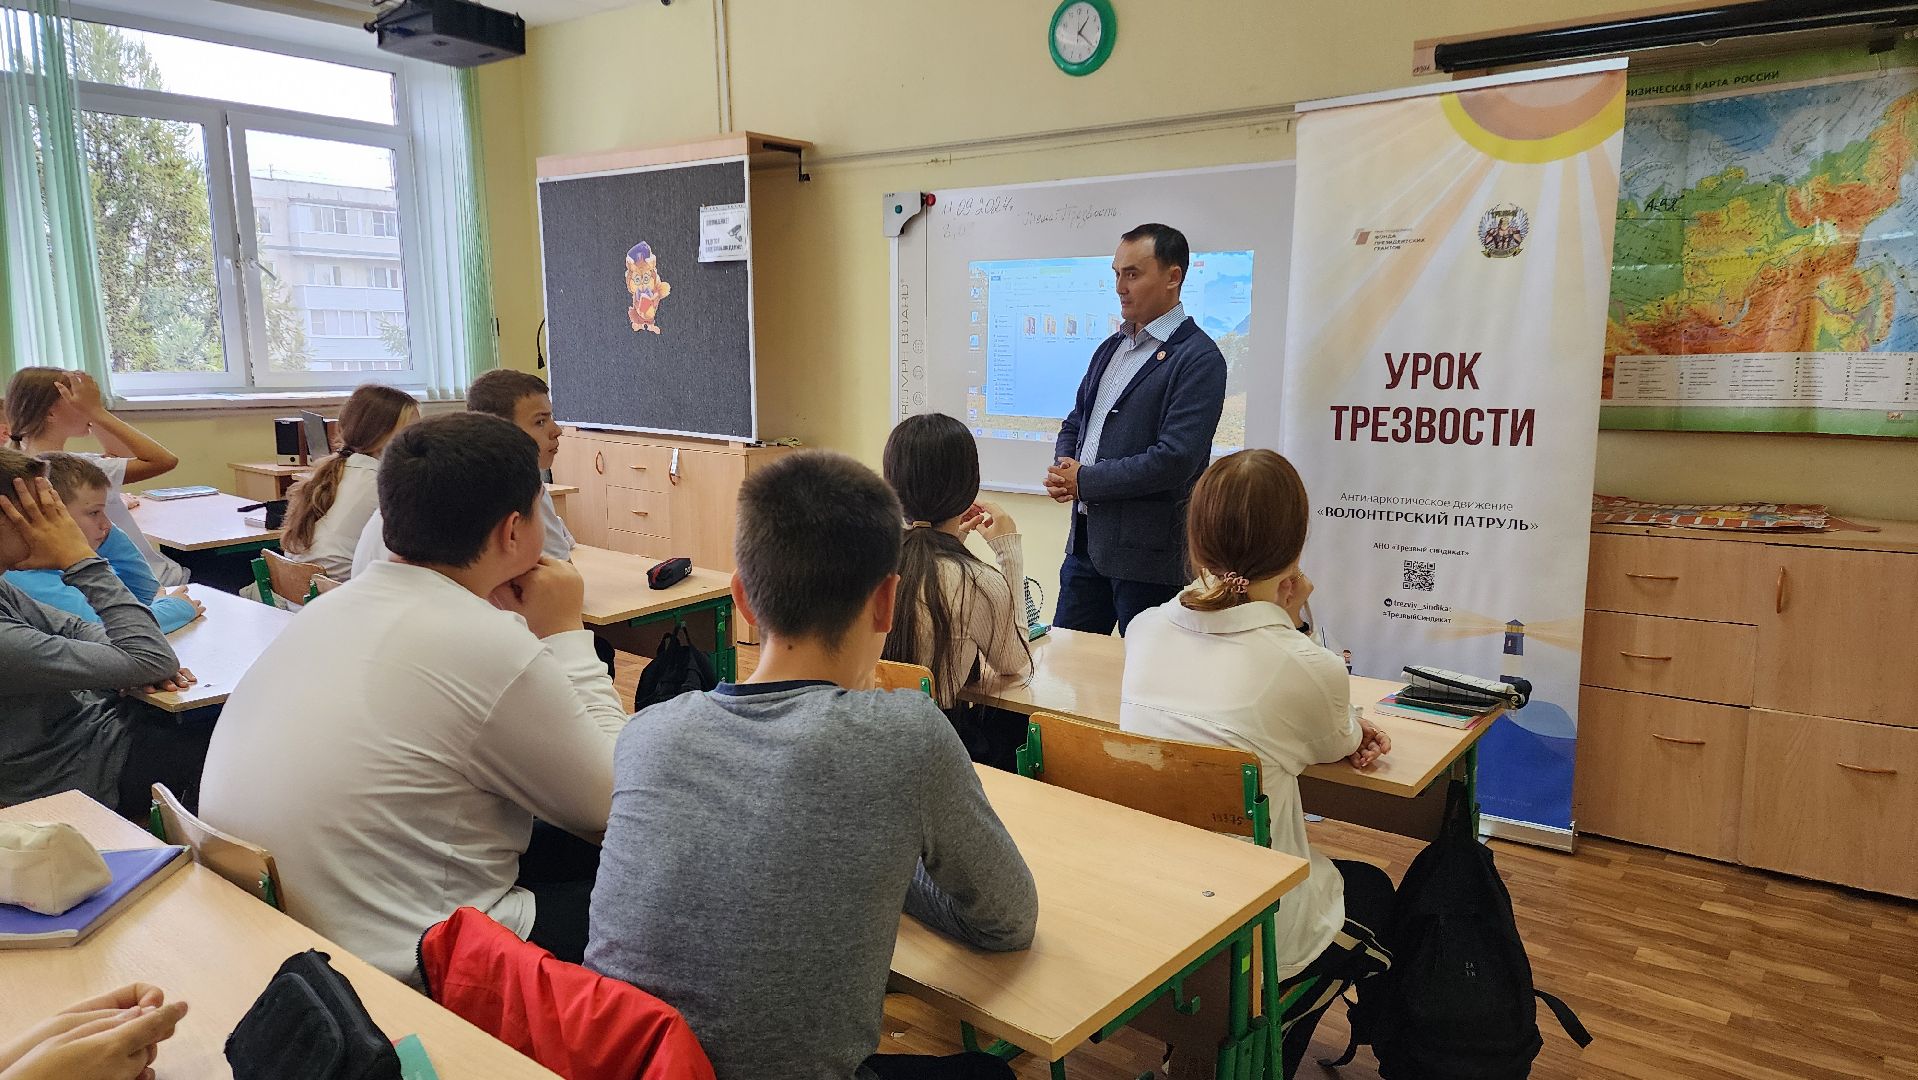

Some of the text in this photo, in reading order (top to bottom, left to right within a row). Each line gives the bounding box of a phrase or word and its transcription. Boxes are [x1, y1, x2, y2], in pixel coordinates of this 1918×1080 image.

[1695, 79, 1729, 91] КАРТА
[1733, 70, 1780, 85] РОССИИ
[1384, 352, 1483, 390] УРОК
[1330, 405, 1536, 447] ТРЕЗВОСТИ
[1340, 492, 1514, 512] Антинаркотическое движение
[1317, 506, 1539, 531] «ВОЛОНТЕРСКИЙ ПАТРУЛЬ»
[1373, 542, 1390, 550] АНО
